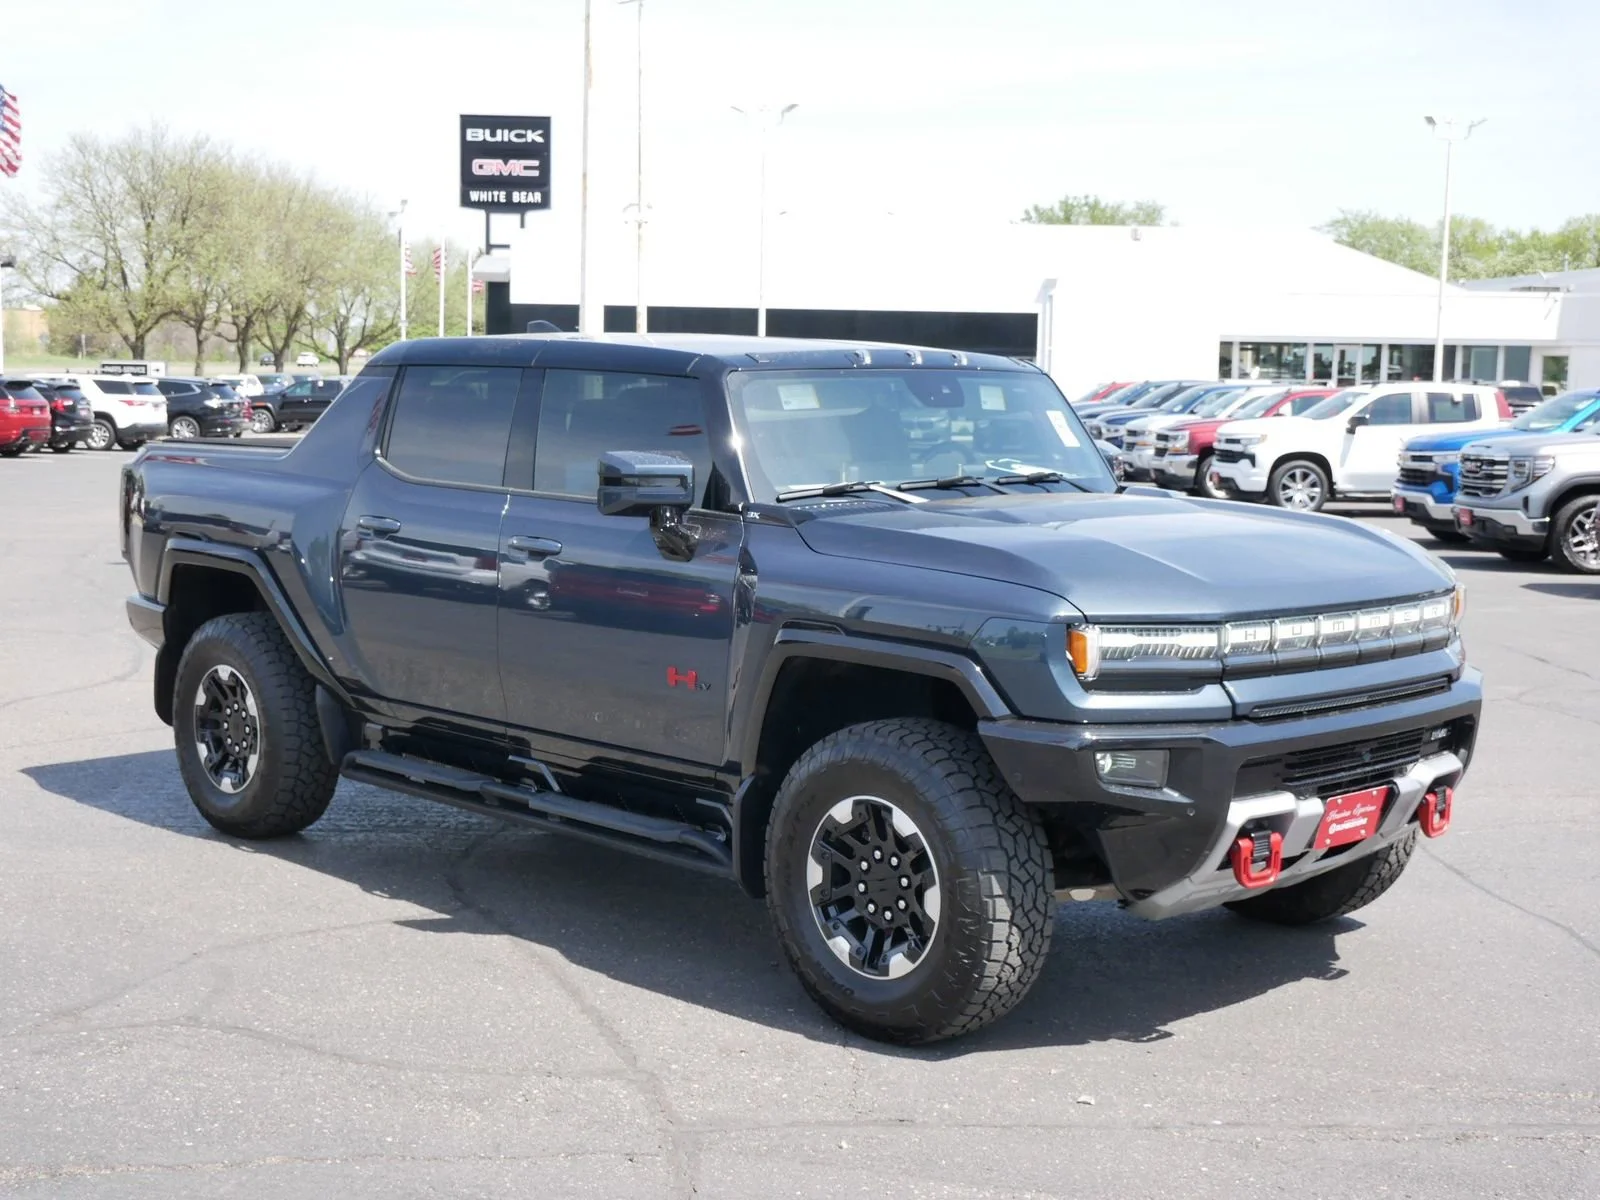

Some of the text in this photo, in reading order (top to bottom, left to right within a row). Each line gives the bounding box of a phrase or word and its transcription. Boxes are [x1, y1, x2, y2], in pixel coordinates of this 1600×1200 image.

[466, 128, 544, 143] BUICK
[472, 159, 539, 176] GMC
[469, 190, 542, 203] WHITE BEAR
[1244, 605, 1440, 640] HUMMER
